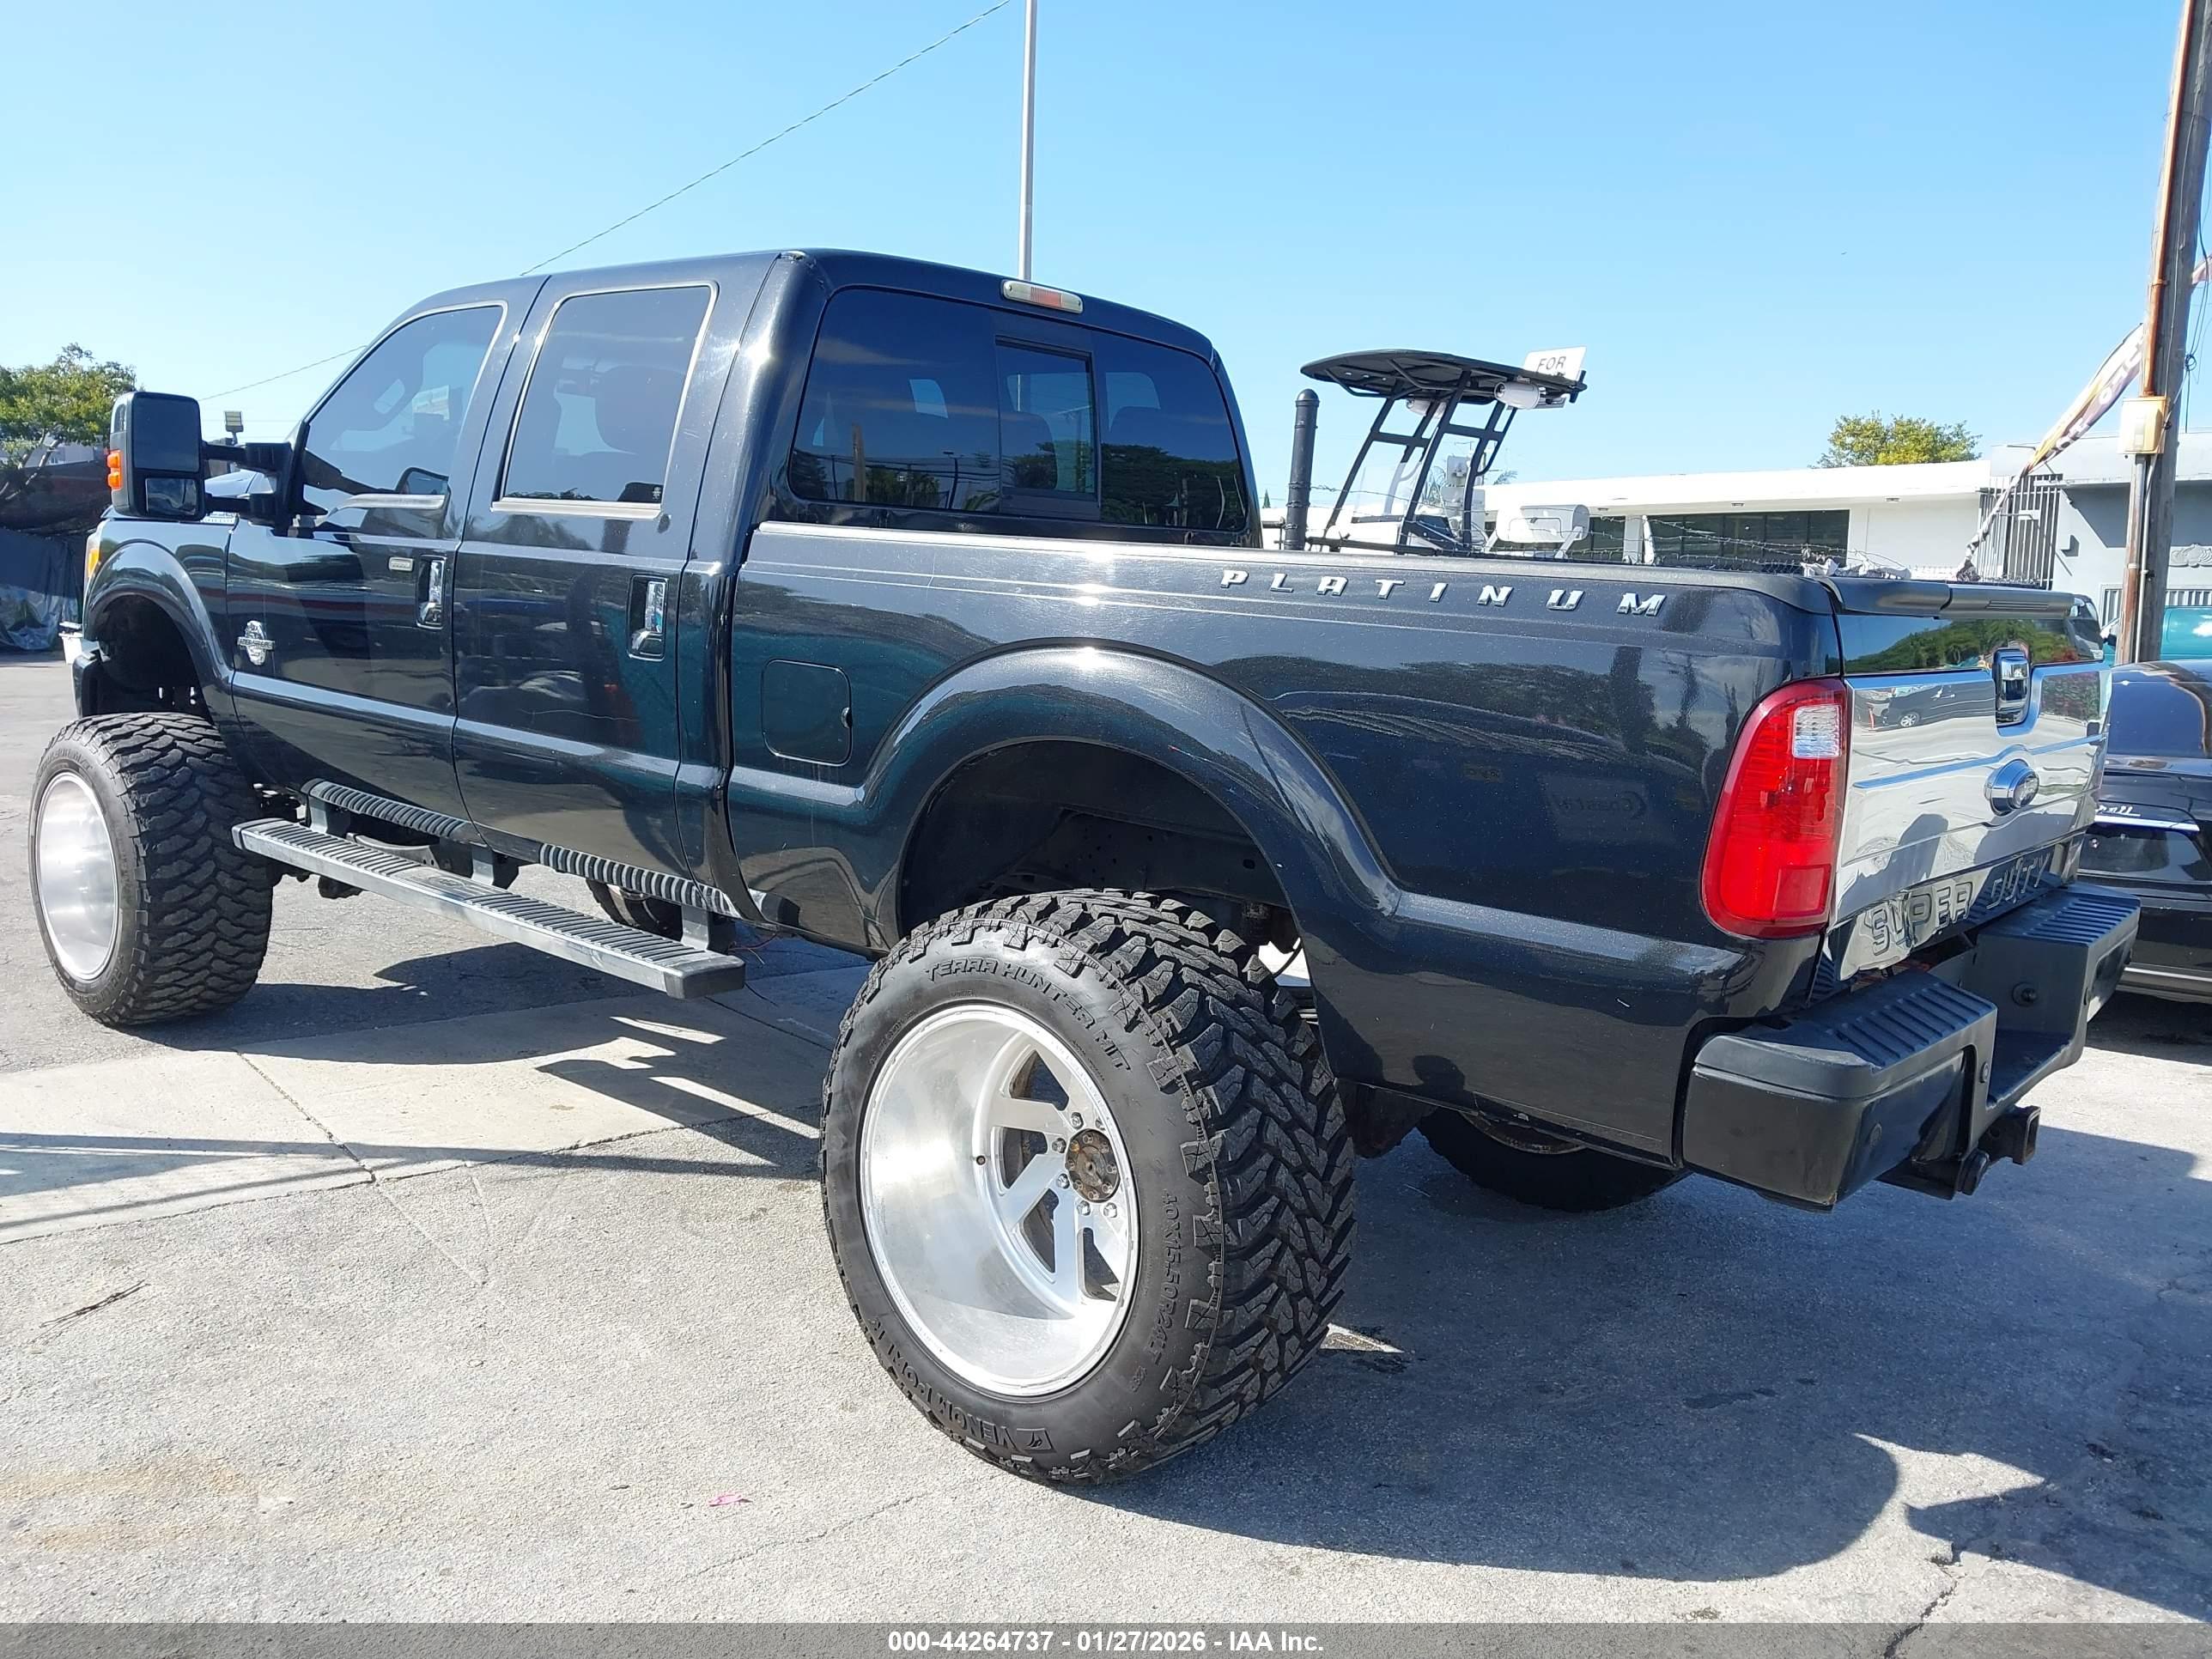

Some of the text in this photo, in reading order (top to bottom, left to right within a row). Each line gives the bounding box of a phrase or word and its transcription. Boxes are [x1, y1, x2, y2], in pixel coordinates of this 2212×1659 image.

[1536, 355, 1567, 372] FOR
[1219, 569, 1667, 617] PLATINUM
[1870, 853, 2051, 957] SUPER DUTY
[925, 956, 999, 983] TERRA
[1001, 962, 1097, 1030] HUNTER
[937, 1392, 1023, 1454] VENOM
